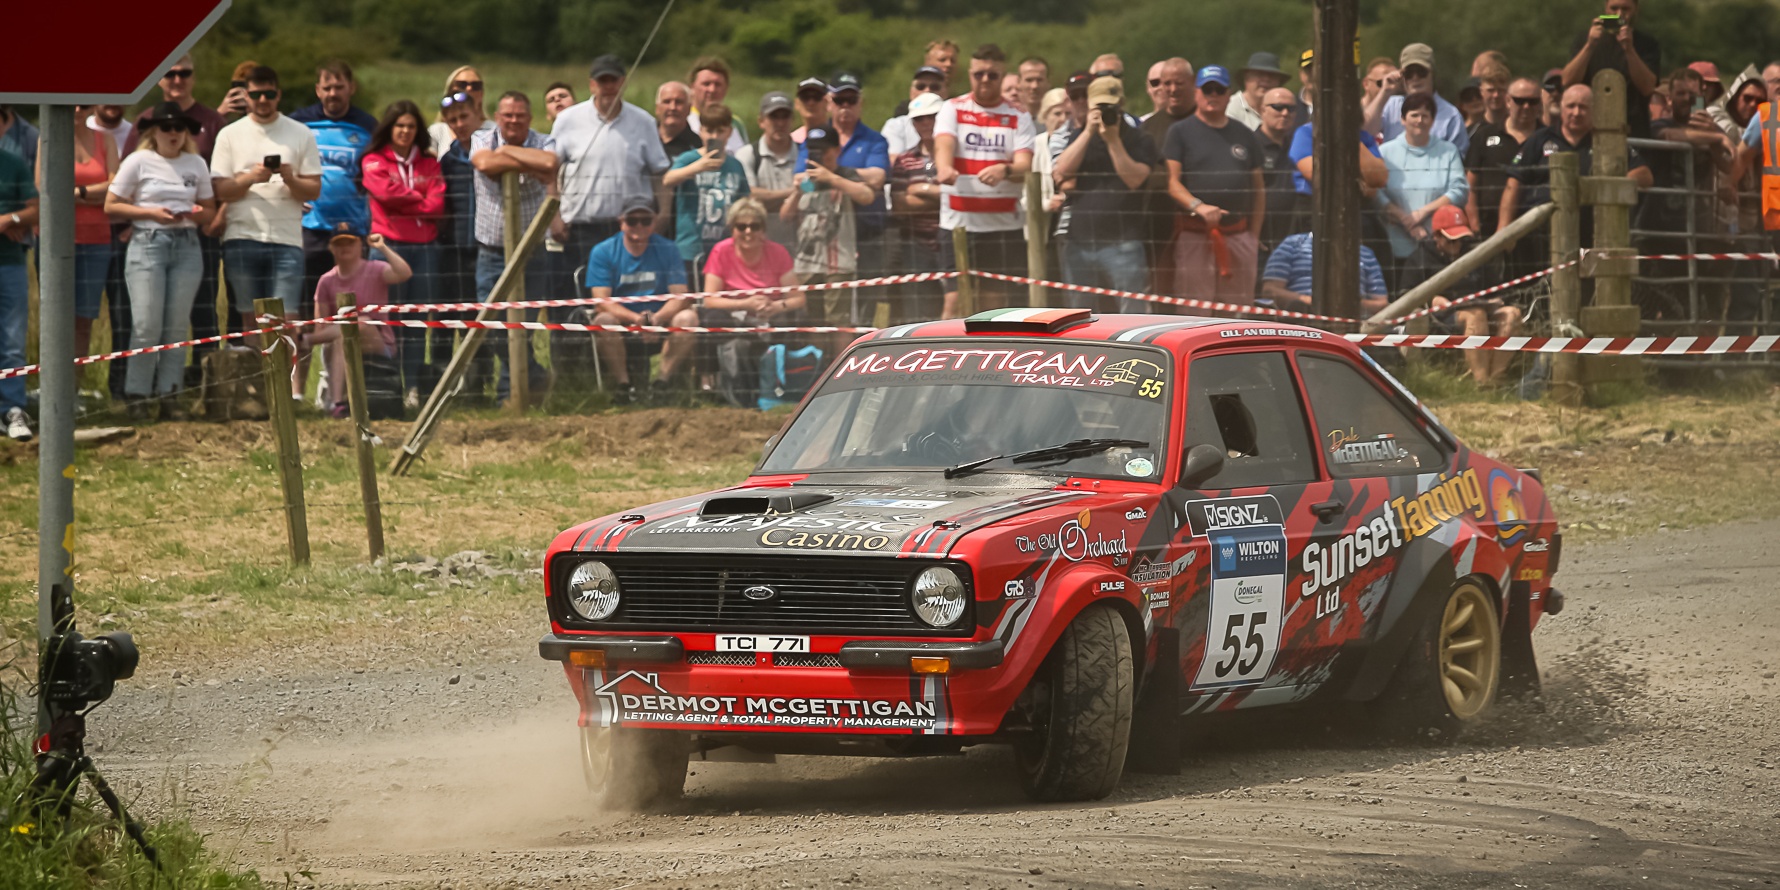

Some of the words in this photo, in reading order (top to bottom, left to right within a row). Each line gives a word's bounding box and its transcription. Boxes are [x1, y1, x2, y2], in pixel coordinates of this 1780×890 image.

[1278, 329, 1323, 339] COMPLEX
[920, 372, 968, 382] COACH
[970, 372, 1004, 382] HIRE
[1012, 373, 1085, 387] TRAVEL
[1090, 378, 1115, 388] LTD
[1138, 378, 1165, 399] 55
[1327, 426, 1361, 453] Dale
[657, 514, 917, 533] MAJESTIC
[1125, 509, 1148, 521] GMAC
[760, 527, 889, 550] Casino
[1301, 500, 1402, 597] Sunset
[1391, 467, 1487, 544] Tanning
[1015, 535, 1037, 553] The
[1038, 533, 1057, 550] Old
[1238, 540, 1280, 556] WILTON
[1004, 579, 1024, 597] GRS
[1100, 581, 1125, 591] PULSE
[1238, 585, 1263, 595] DONEGAL
[1315, 586, 1341, 619] Ltd
[721, 636, 757, 651] TCI
[1214, 611, 1268, 678] 55
[623, 694, 738, 713] DERMOT
[747, 696, 936, 717] MCGETTIGAN
[624, 711, 674, 722] LETTING
[676, 713, 719, 723] AGENT
[720, 714, 729, 723] &
[731, 714, 771, 725] TOTAL
[774, 715, 842, 727] PROPERTY
[845, 716, 936, 728] MANAGEMENT
